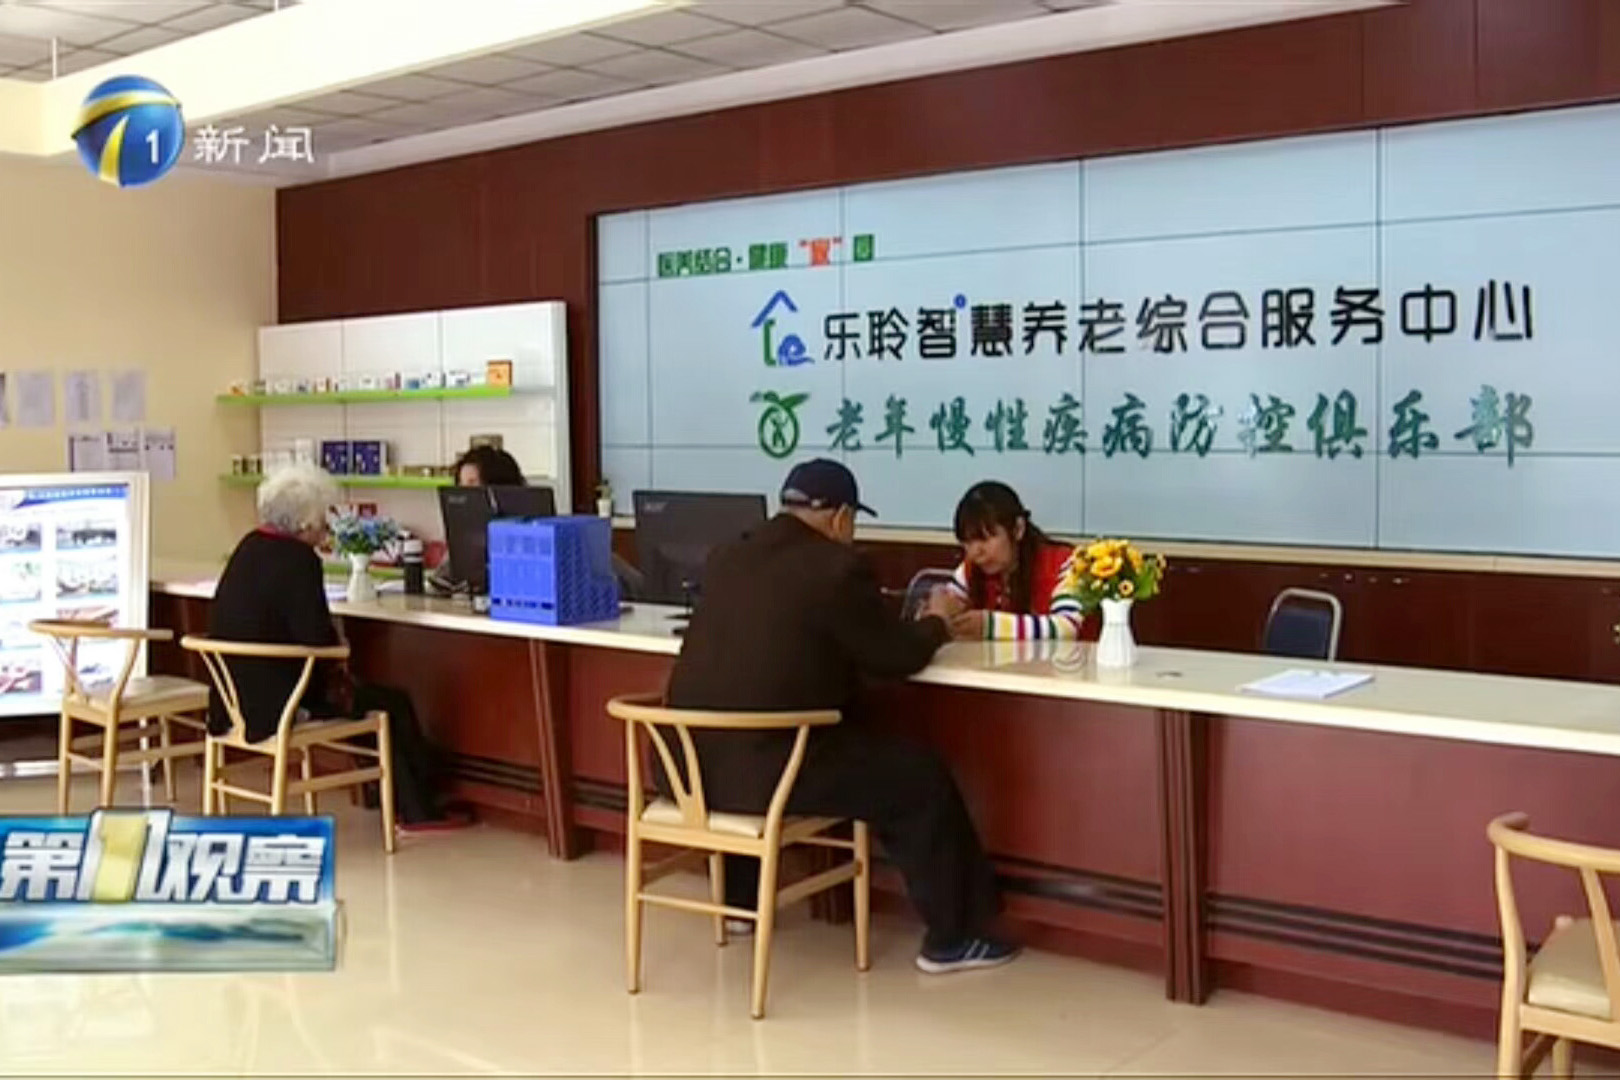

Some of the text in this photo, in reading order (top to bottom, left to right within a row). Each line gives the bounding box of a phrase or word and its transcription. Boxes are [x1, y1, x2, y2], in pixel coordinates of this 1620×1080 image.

[822, 279, 1534, 362] 乐聆智慧养老综合服务中心
[825, 383, 1534, 468] 老年慢性疾病防控俱乐部
